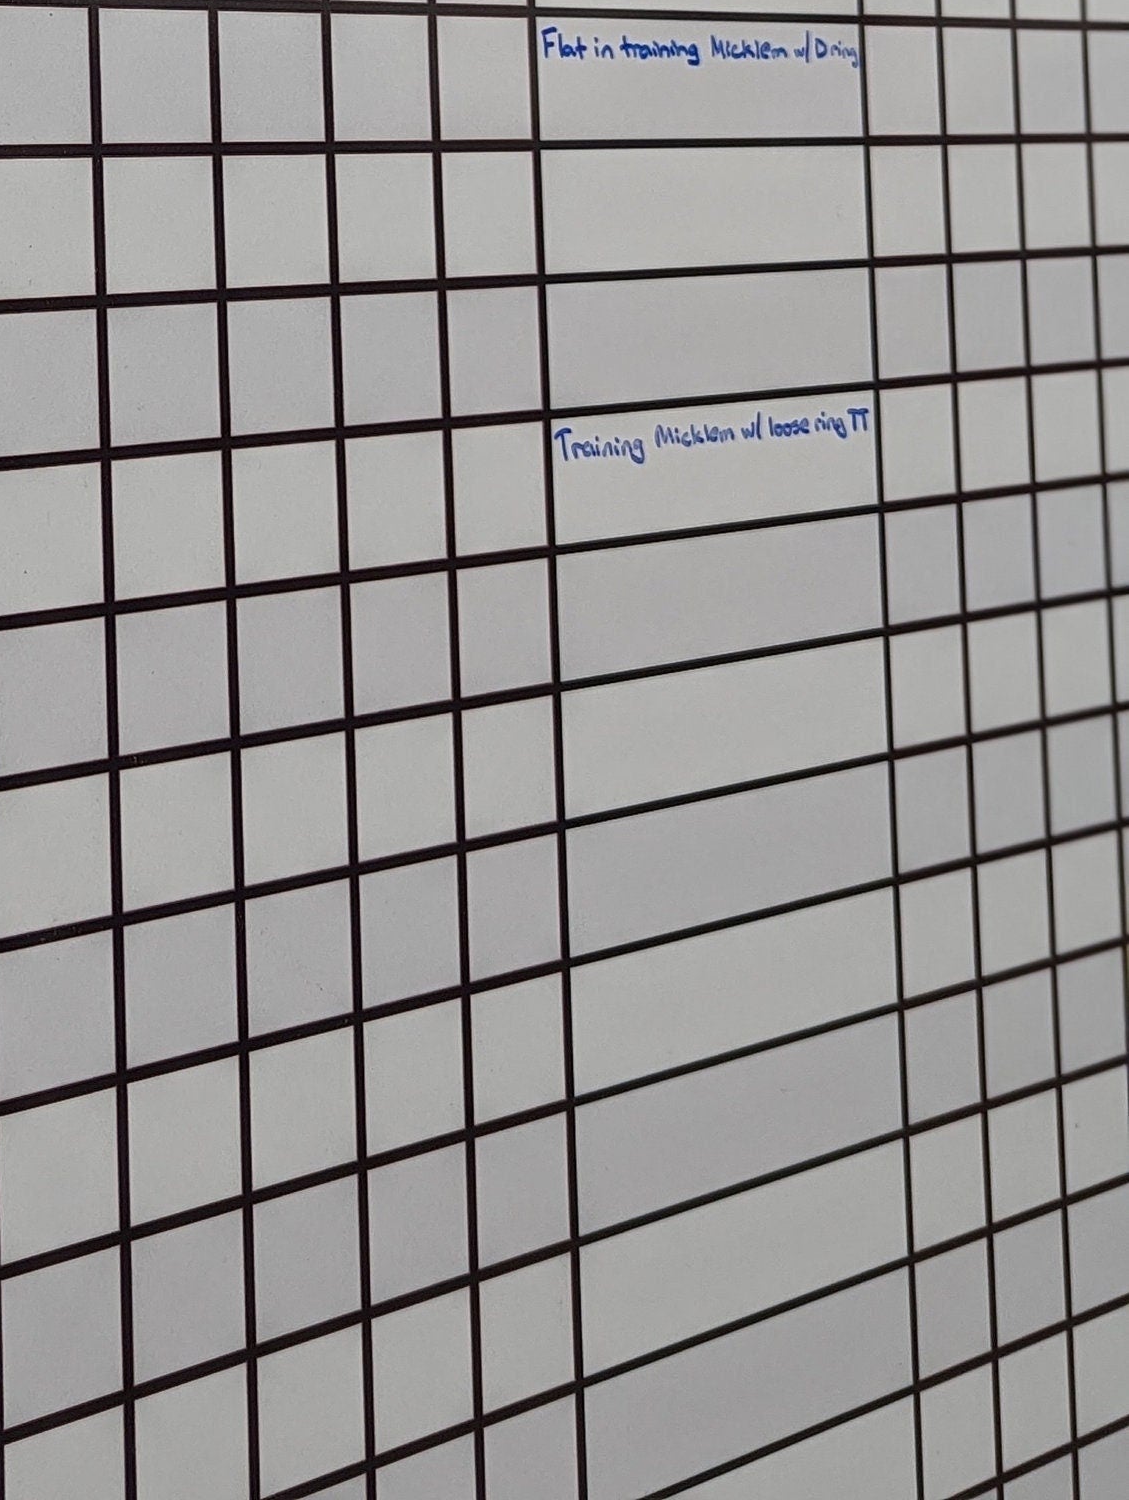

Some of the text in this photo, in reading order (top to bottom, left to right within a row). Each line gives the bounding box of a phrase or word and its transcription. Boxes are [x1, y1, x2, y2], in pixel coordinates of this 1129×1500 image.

[540, 27, 587, 60] Flat
[594, 40, 615, 59] in
[620, 36, 701, 66] training
[710, 34, 788, 59] Micklem
[831, 40, 859, 68] ring
[554, 427, 646, 464] Training
[654, 424, 736, 448] Micklem
[740, 411, 761, 439] w/
[768, 415, 810, 438] loose
[814, 411, 847, 439] ring
